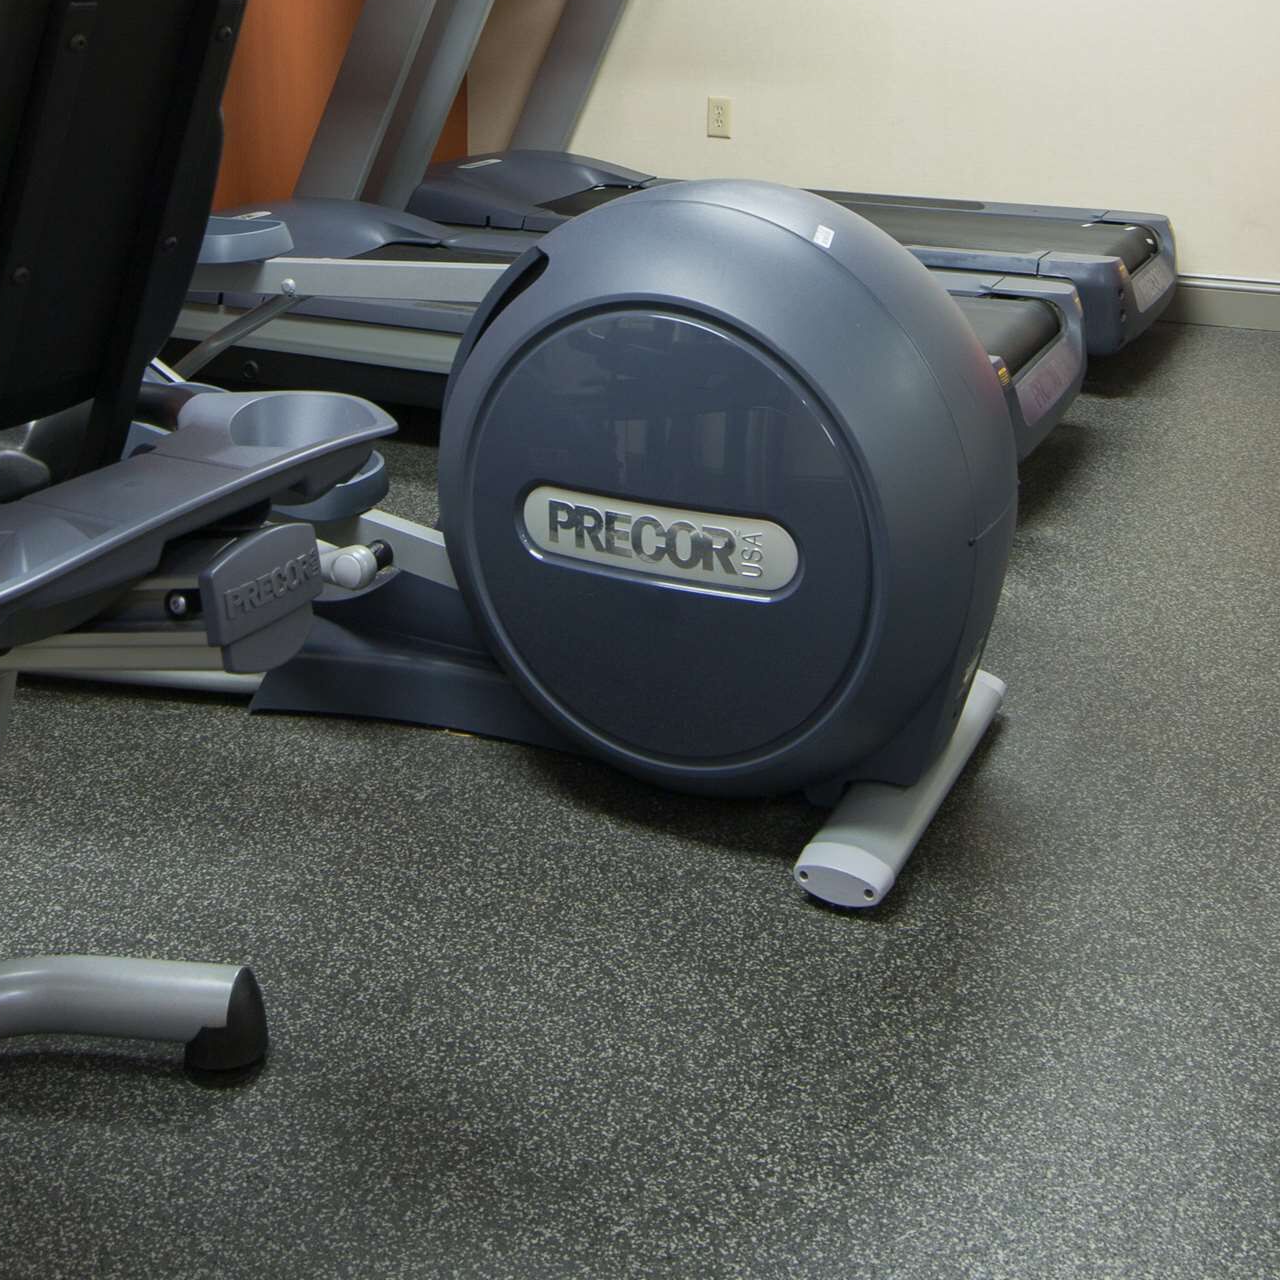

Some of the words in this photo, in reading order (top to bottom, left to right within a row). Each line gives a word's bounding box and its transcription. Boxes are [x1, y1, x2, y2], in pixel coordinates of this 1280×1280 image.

[547, 497, 740, 576] PRECOR
[740, 531, 764, 578] USA
[223, 551, 314, 620] PRECOR
